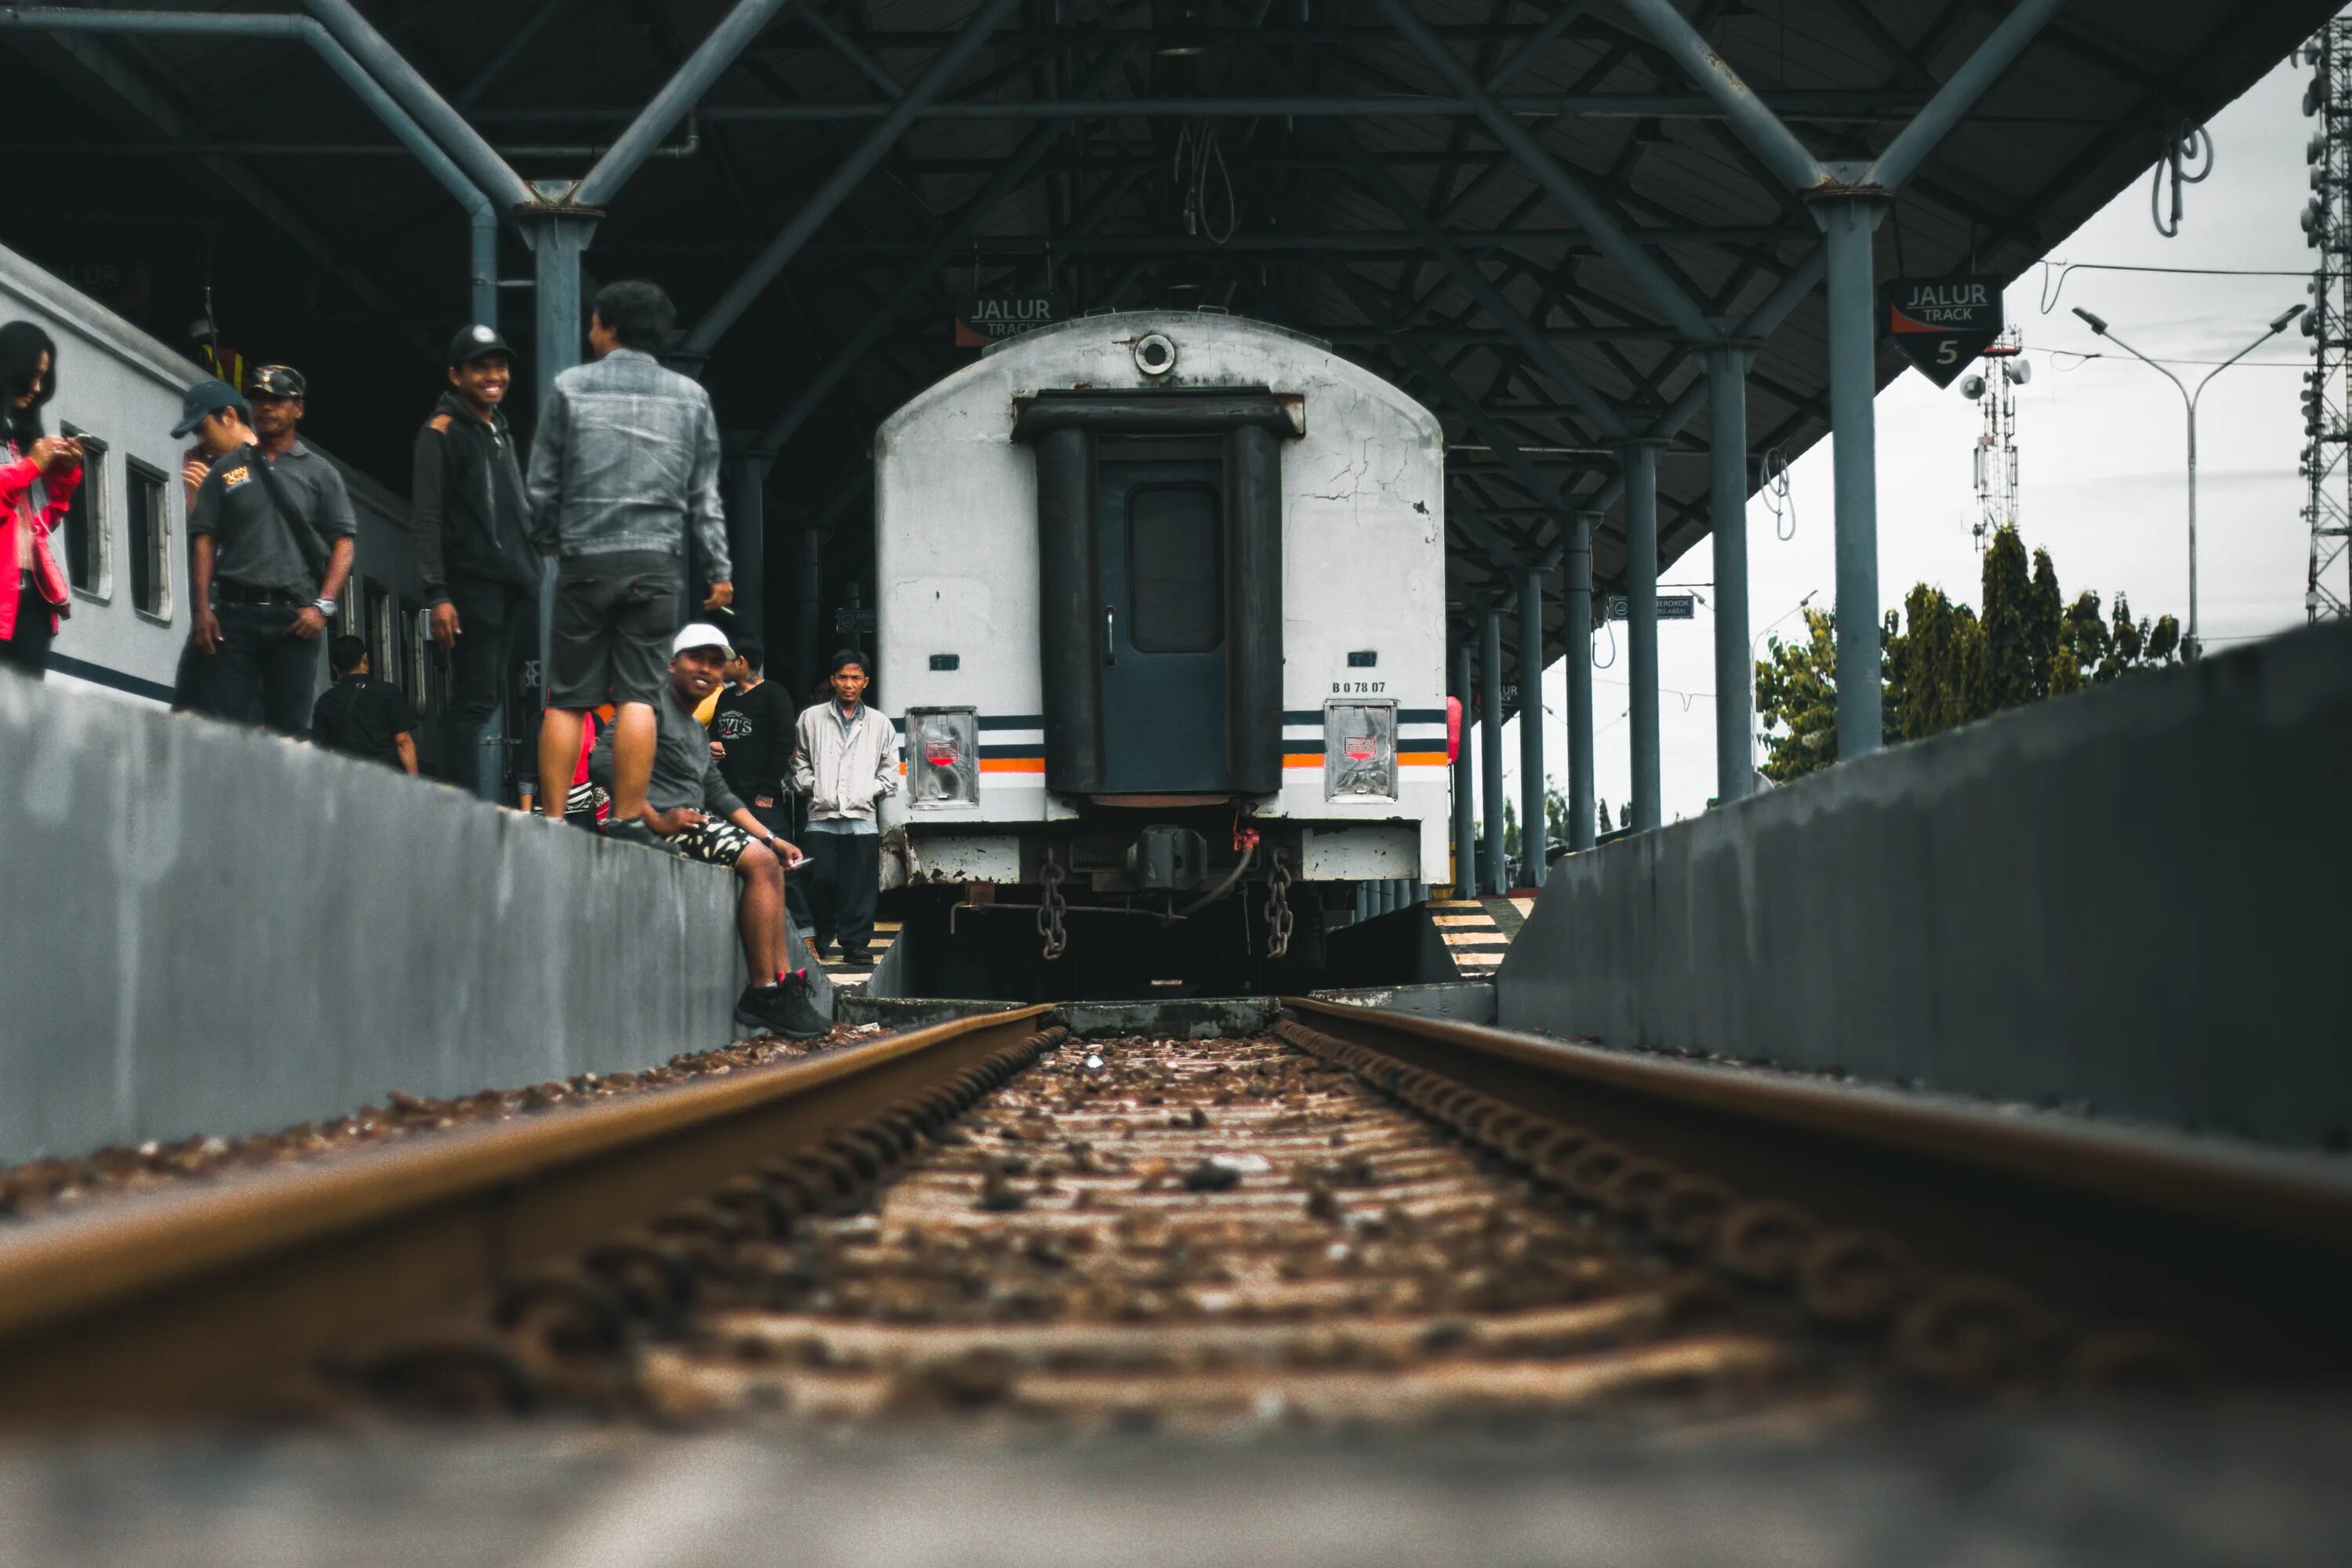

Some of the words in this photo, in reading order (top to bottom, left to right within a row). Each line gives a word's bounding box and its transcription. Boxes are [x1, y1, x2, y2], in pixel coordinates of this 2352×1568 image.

[1907, 283, 1987, 306] JALUR
[971, 299, 1051, 320] JALUR
[1923, 307, 1973, 321] TRACK
[987, 322, 1036, 336] TRACK
[1935, 340, 1958, 365] 5
[717, 718, 753, 734] EVI'S
